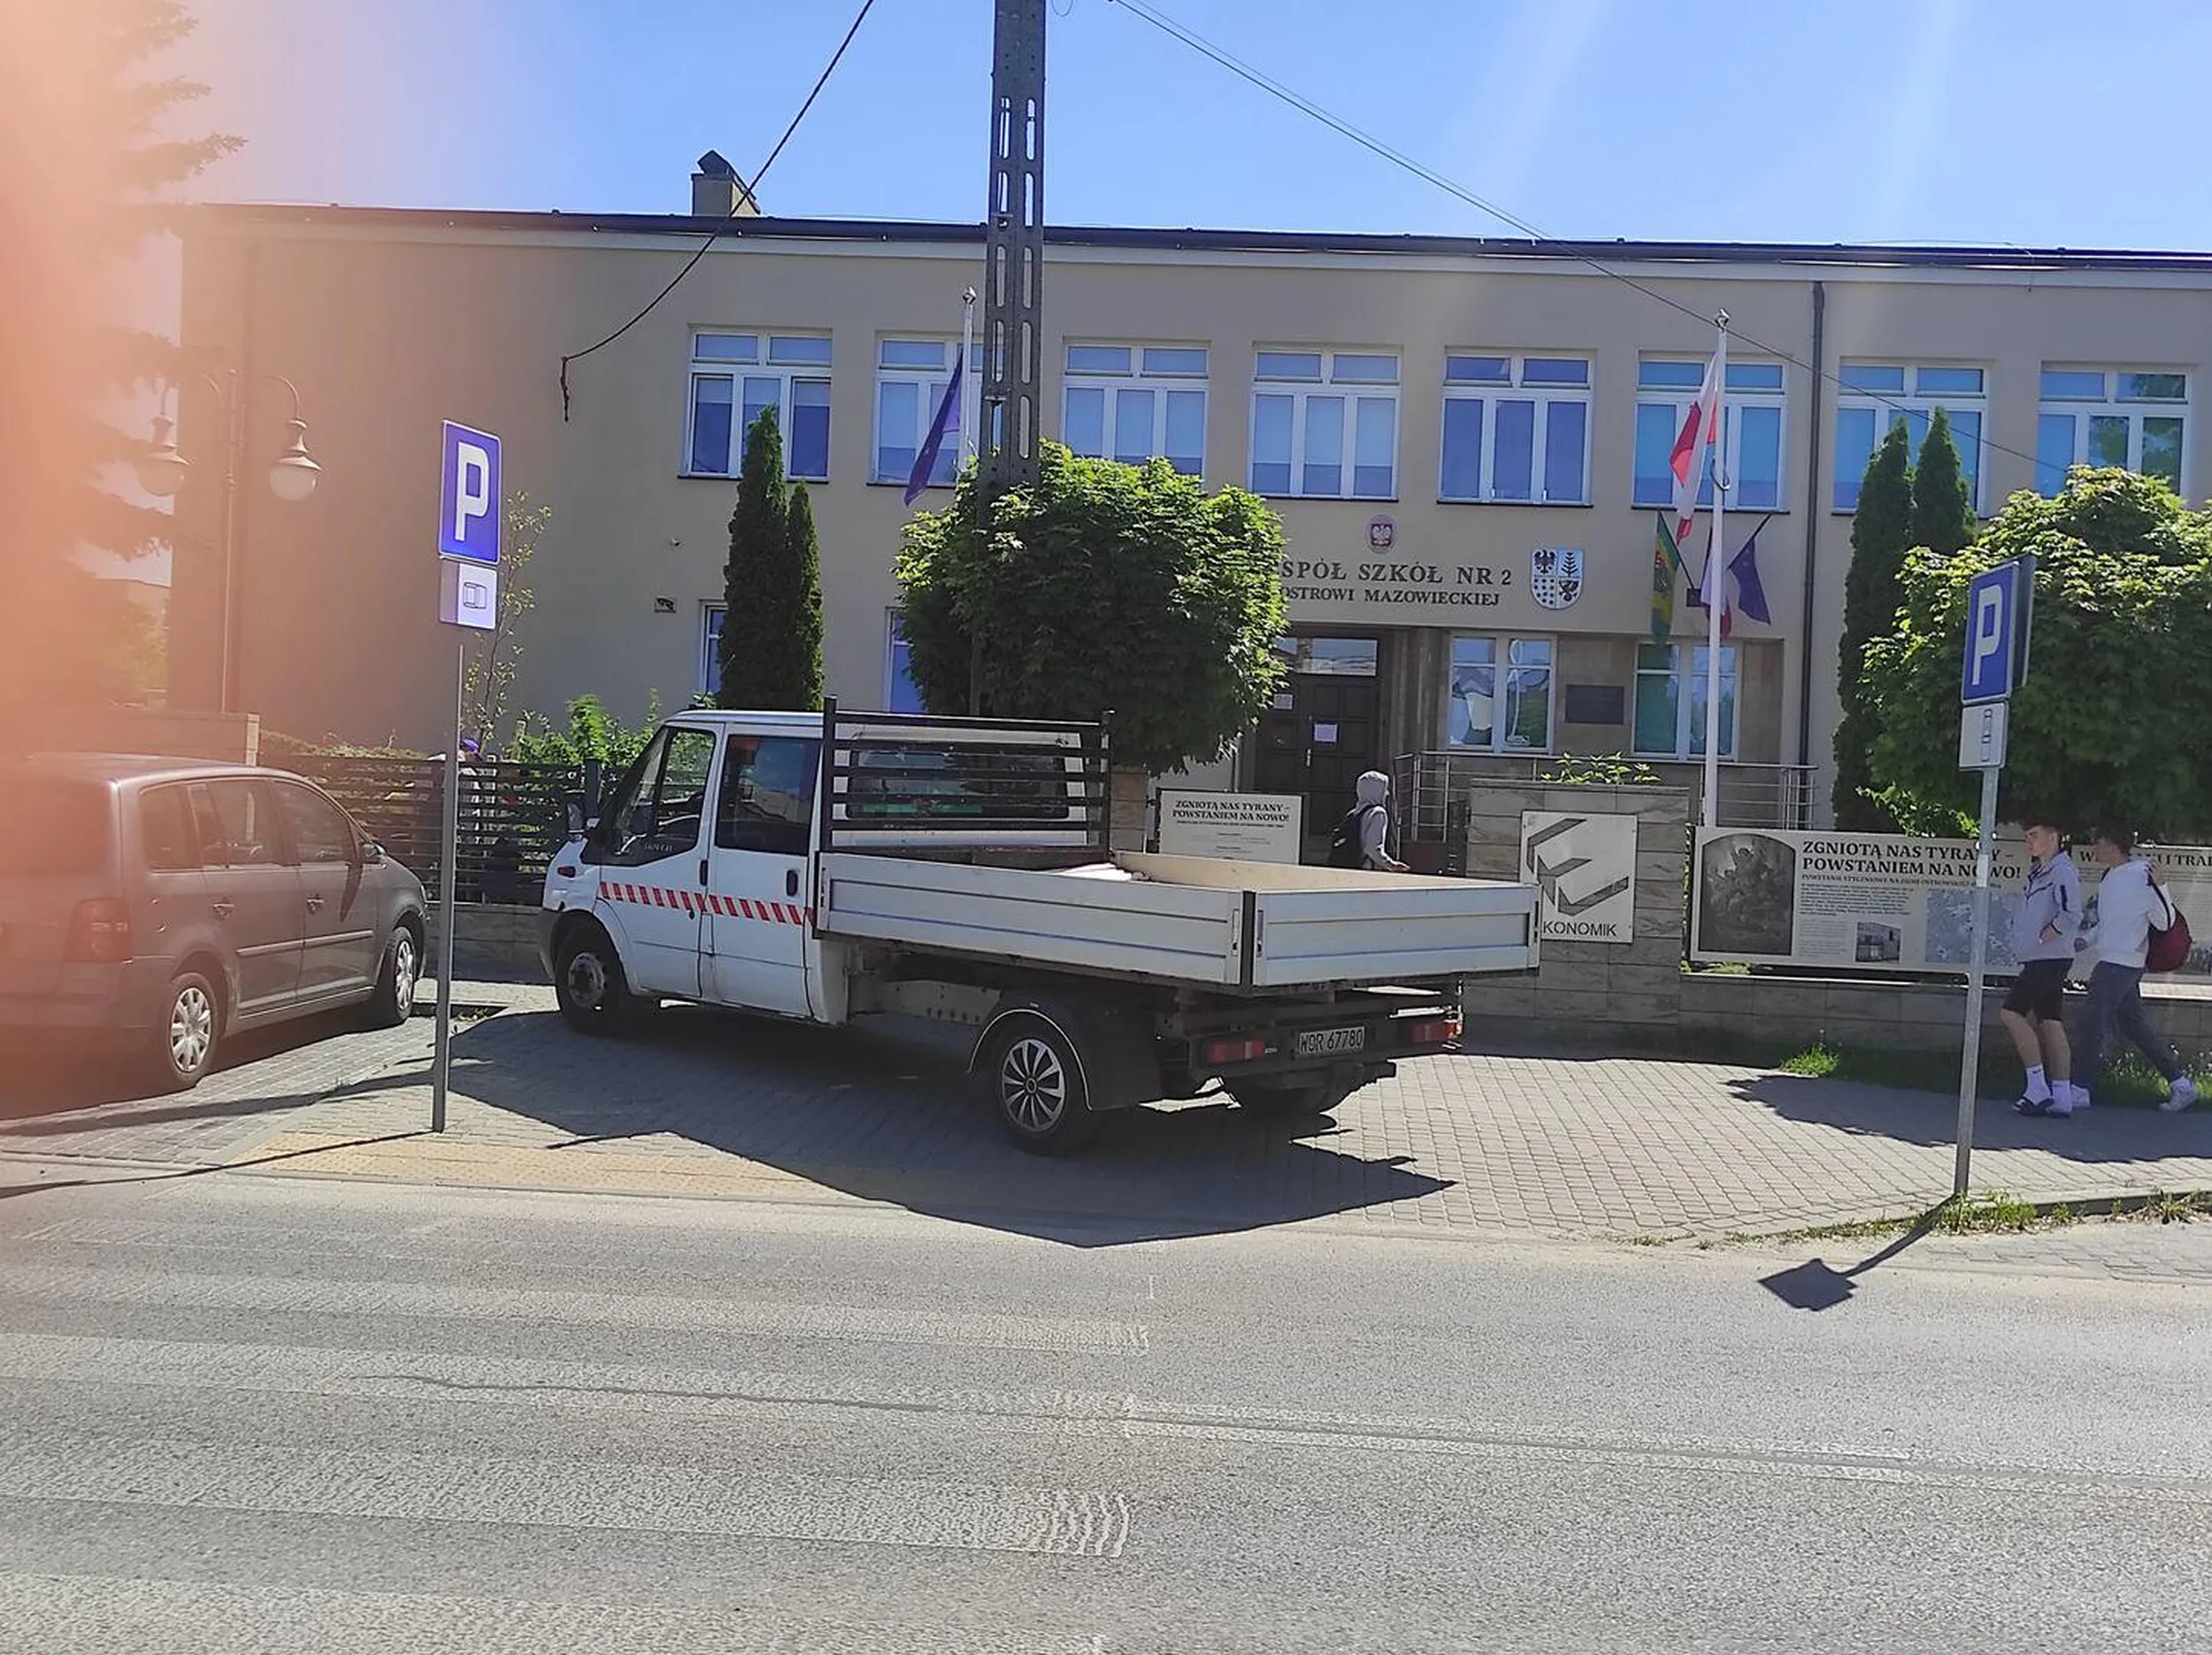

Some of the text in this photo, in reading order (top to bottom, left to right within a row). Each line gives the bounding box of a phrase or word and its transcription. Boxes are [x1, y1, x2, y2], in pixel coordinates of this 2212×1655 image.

[455, 441, 489, 542] P
[1281, 557, 1512, 586] SPÓŁ SZKÓŁ NR 2
[1279, 586, 1501, 607] OSTROWI MAZOWIECKIEJ
[1971, 584, 2003, 686] P
[1175, 801, 1218, 811] ZGNIOTĄ
[1220, 802, 1240, 811] NAS
[1241, 803, 1284, 812] TYRANY
[1802, 841, 1881, 860] ZGNIOTĄ
[1886, 846, 1923, 859] NAS
[1926, 847, 2001, 862] TYRAY
[1802, 858, 1924, 875] POWSTANIEM
[1929, 862, 1953, 876] NA
[1543, 921, 1617, 937] KONOMIK
[1327, 1029, 1363, 1050] 67780
